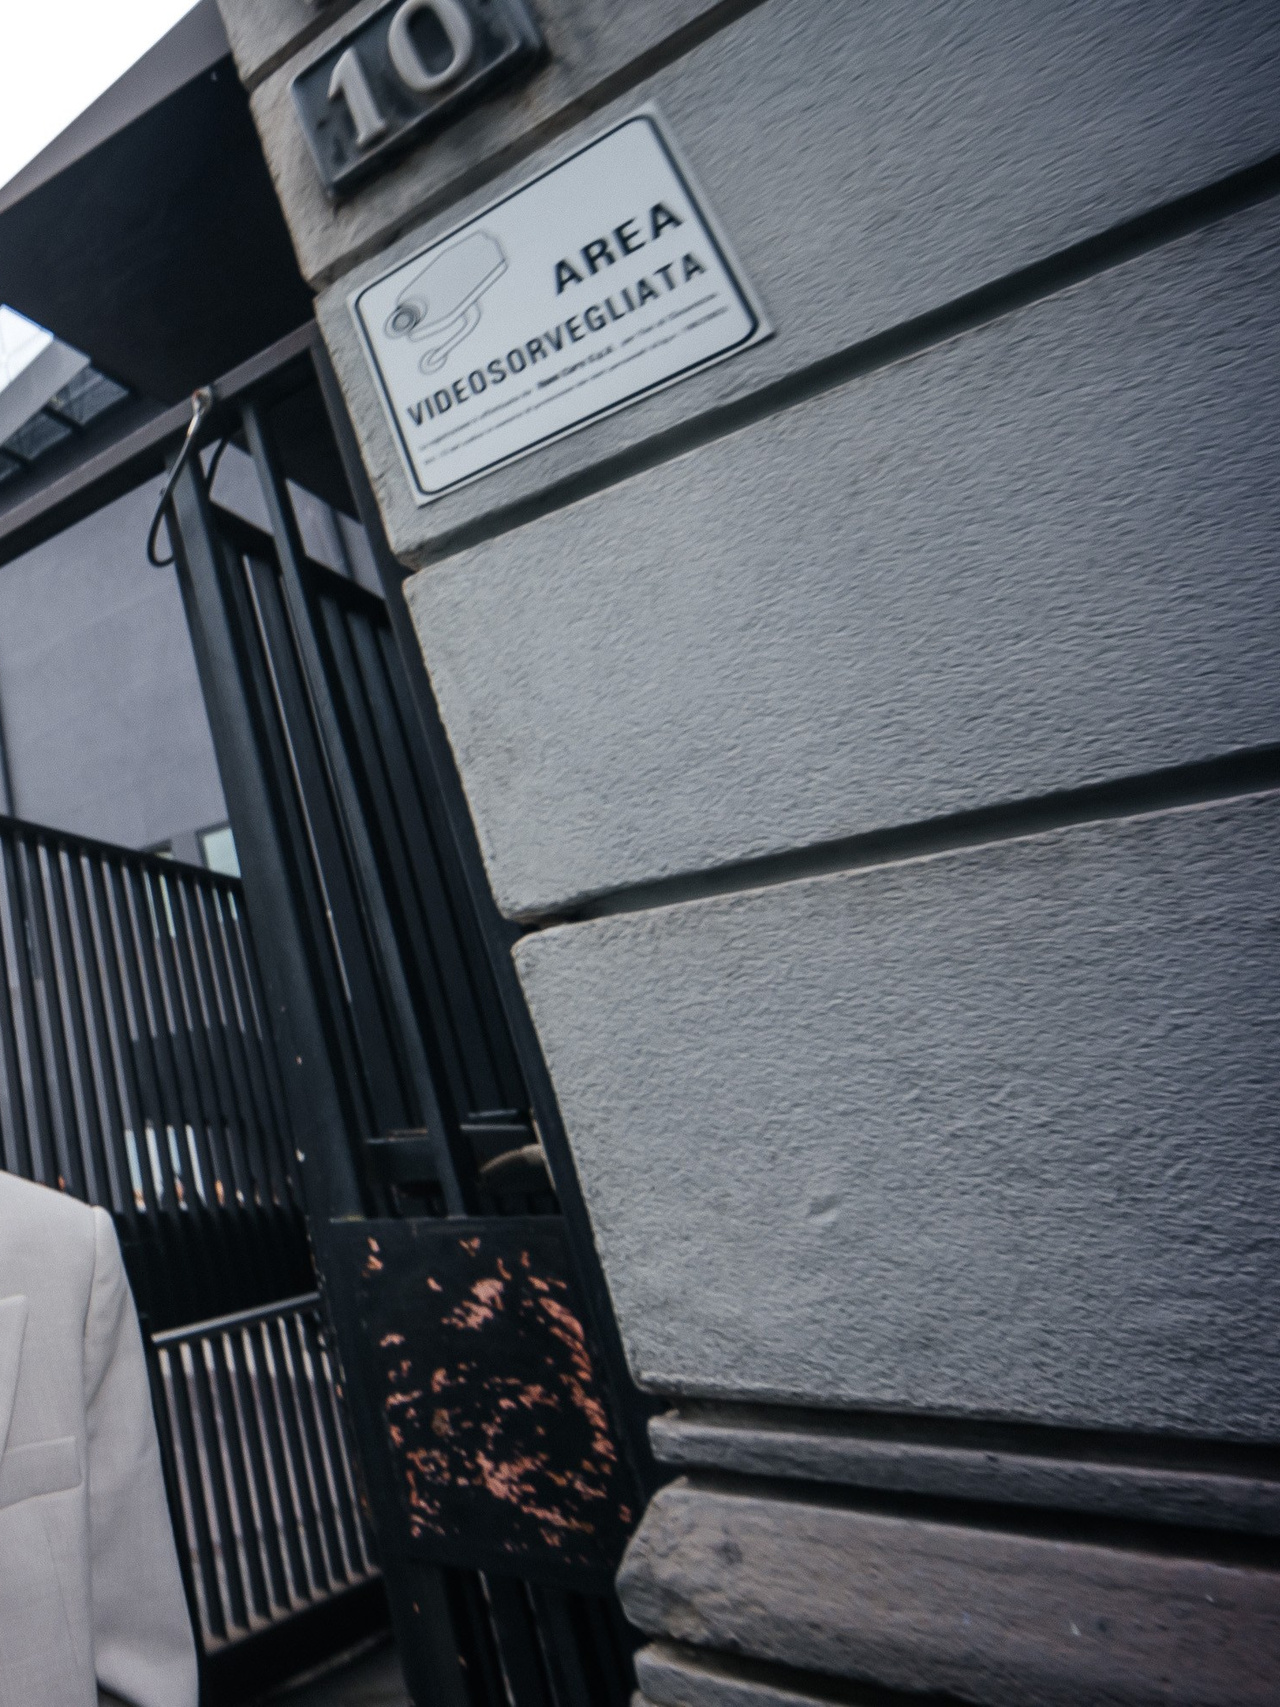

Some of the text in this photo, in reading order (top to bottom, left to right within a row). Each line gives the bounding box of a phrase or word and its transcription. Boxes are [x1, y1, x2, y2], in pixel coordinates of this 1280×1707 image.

[326, 0, 474, 147] 10
[552, 201, 686, 297] AREA
[405, 251, 708, 428] VIDEOSORVEGLIATA
